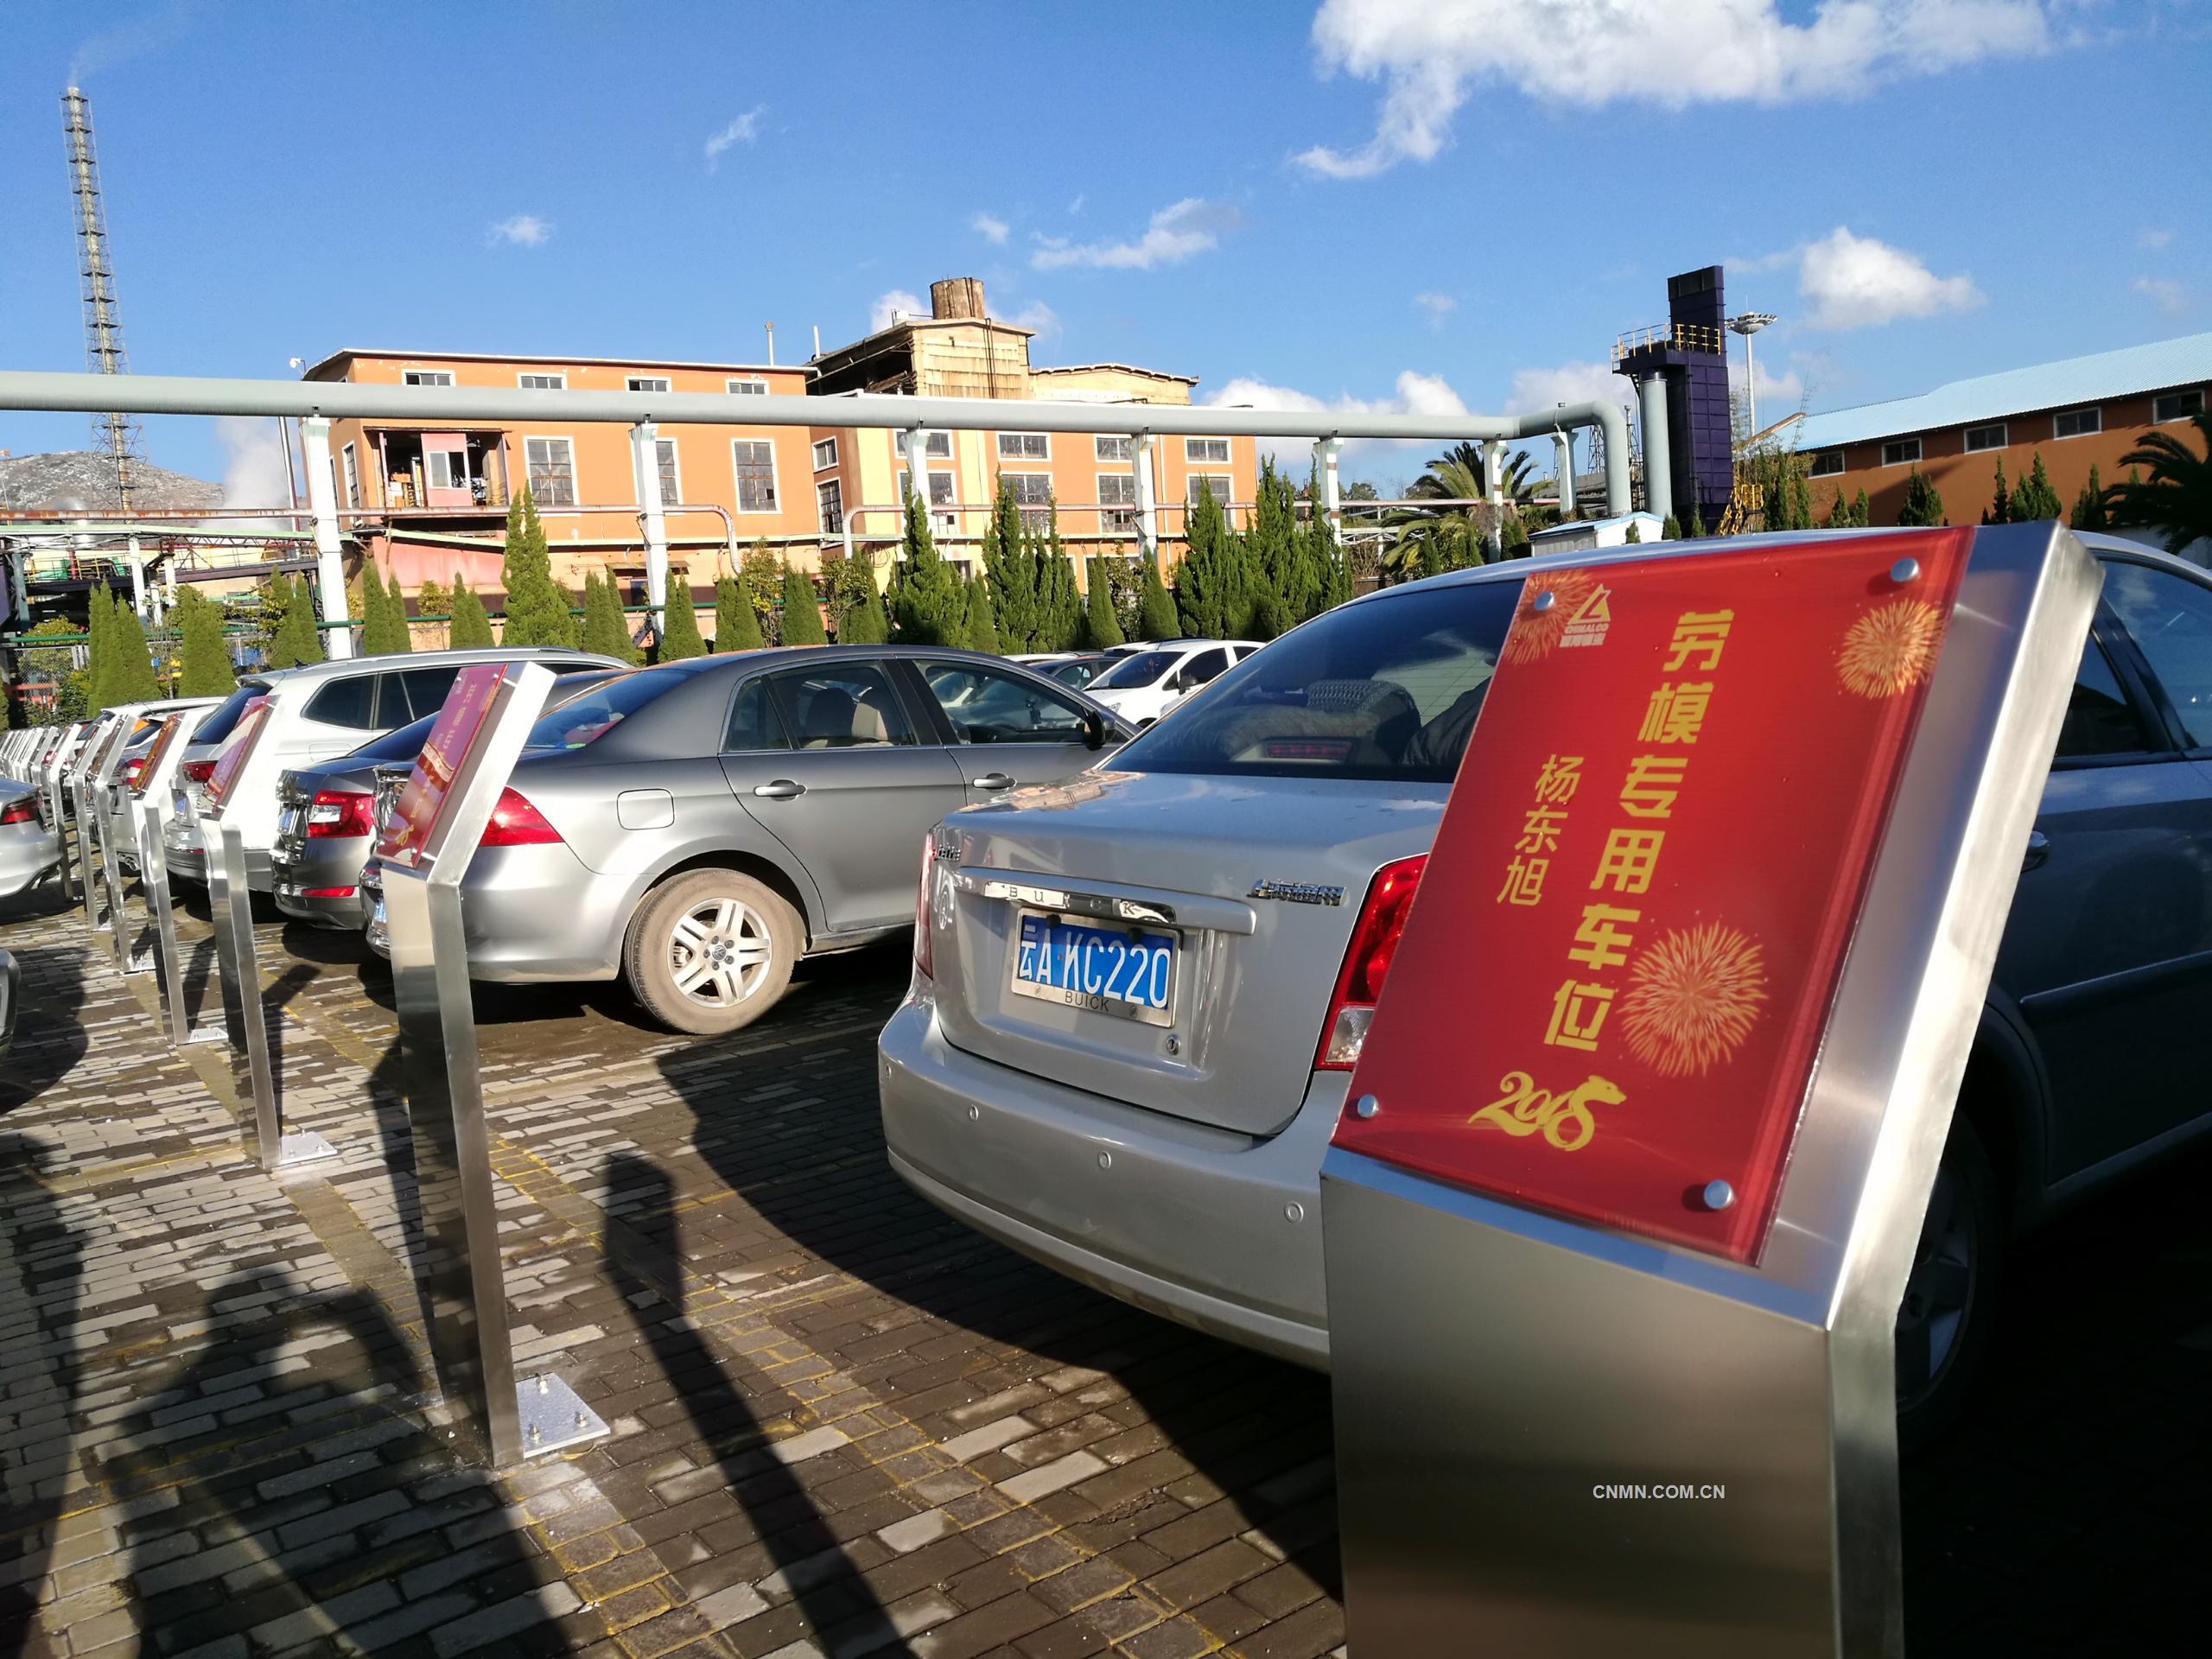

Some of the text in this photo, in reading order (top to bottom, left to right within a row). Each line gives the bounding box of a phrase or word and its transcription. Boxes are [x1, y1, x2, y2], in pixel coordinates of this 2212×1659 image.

[1497, 753, 1584, 906] 杨东旭
[1543, 608, 1734, 1052] 劳模专用车位
[1065, 990, 1109, 1013] BUICK
